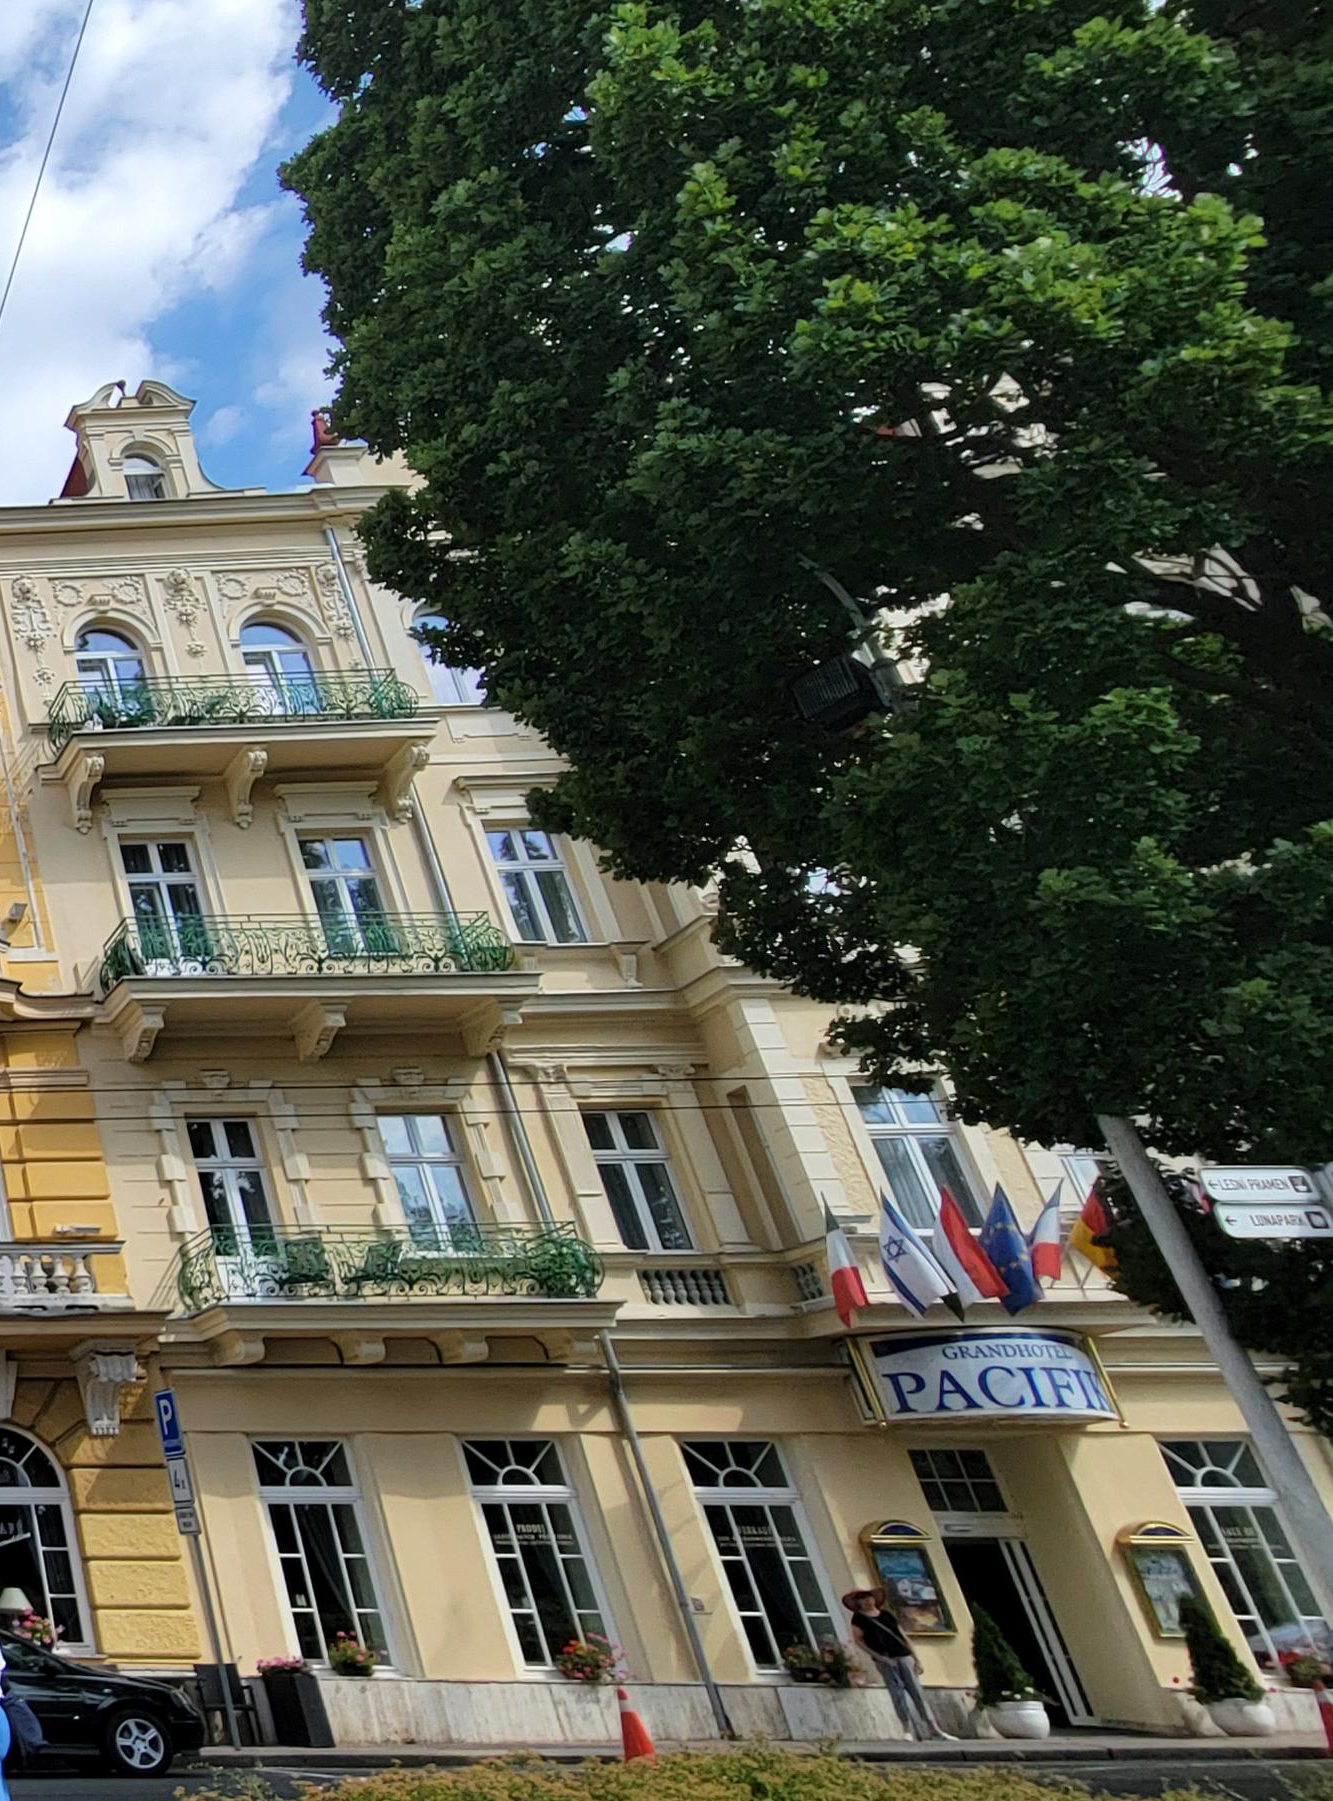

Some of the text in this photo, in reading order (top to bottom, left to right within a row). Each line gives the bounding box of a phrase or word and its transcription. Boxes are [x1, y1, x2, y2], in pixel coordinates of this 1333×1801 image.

[1250, 1214, 1308, 1227] LUNAPARK
[942, 1343, 1073, 1361] GRANDHOTEL
[881, 1365, 1112, 1415] PACIFIK
[159, 1398, 173, 1436] P
